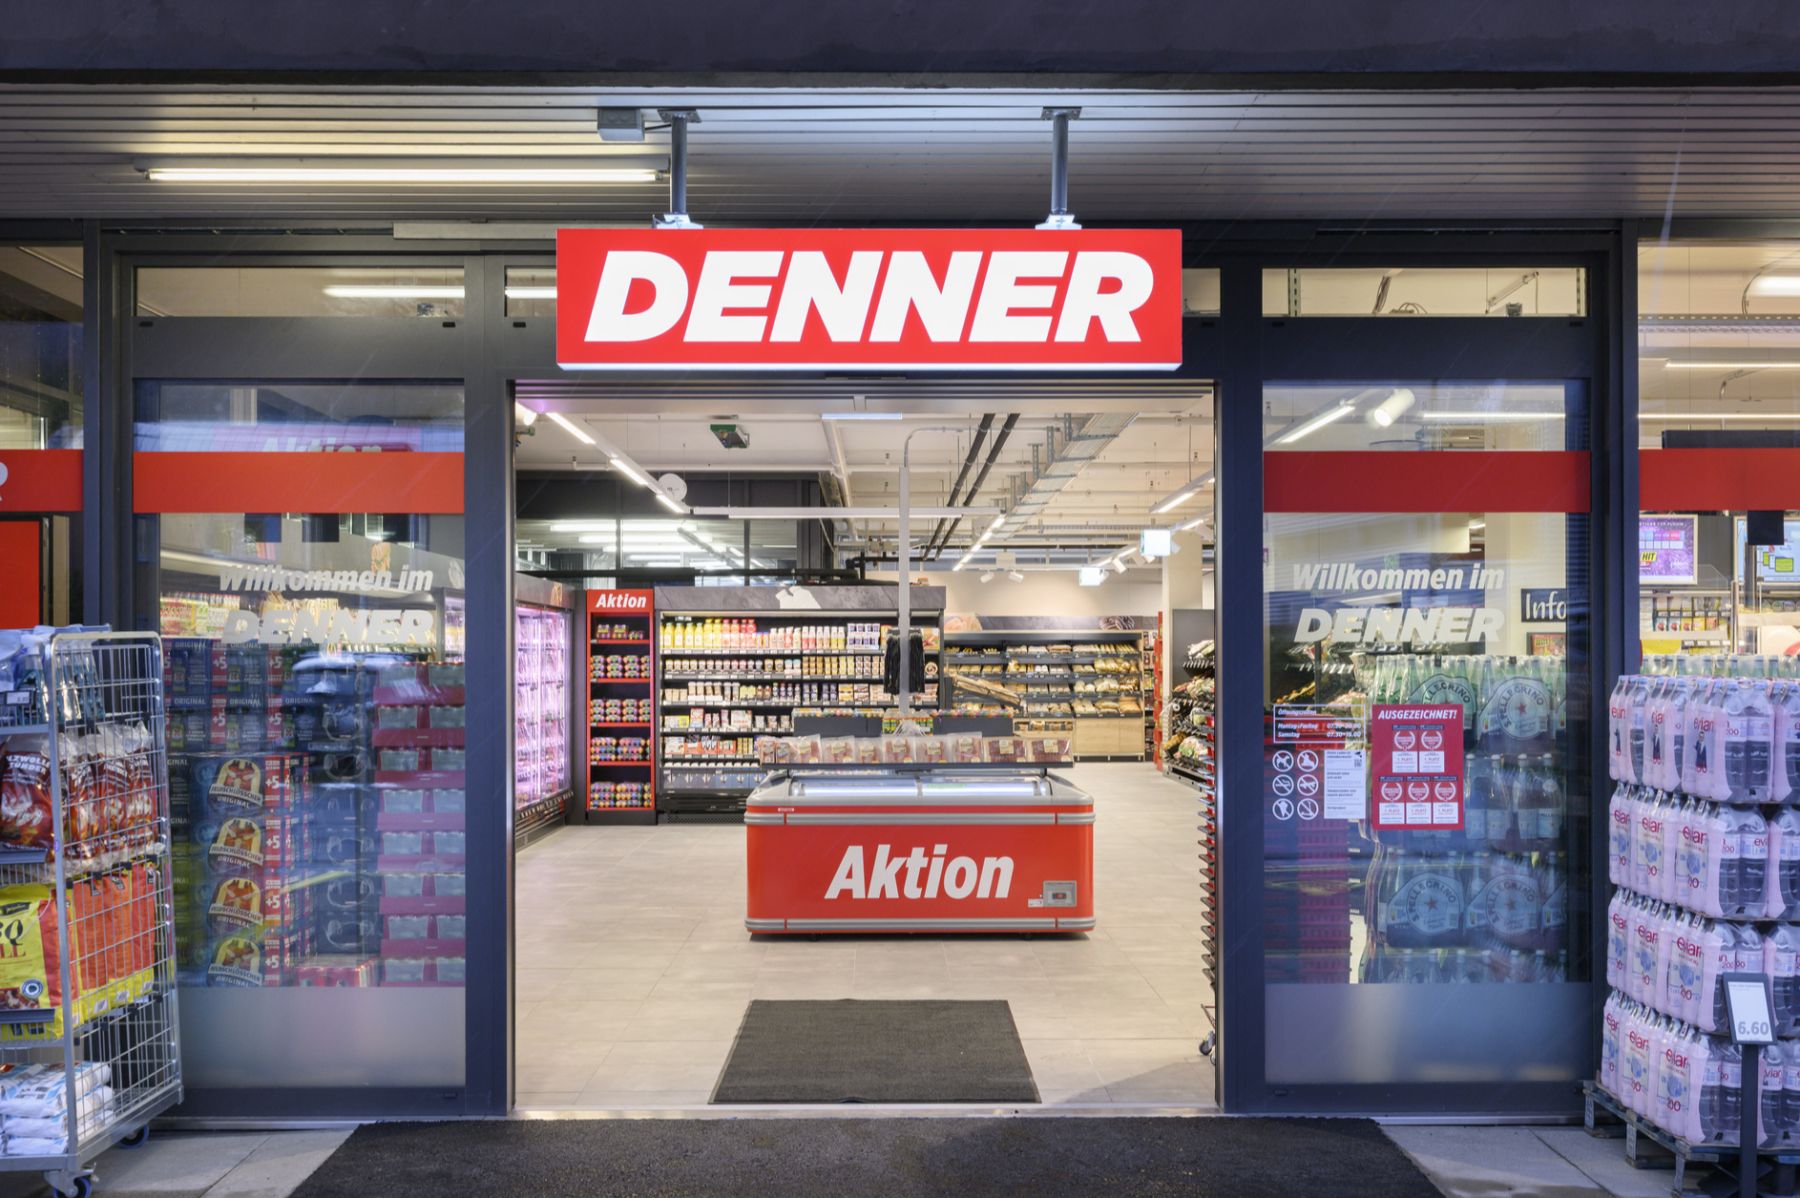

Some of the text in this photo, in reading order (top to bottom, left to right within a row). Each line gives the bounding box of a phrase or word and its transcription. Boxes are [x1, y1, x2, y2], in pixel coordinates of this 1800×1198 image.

[584, 250, 1154, 342] DENNER
[219, 564, 434, 592] Willkommen im
[1293, 563, 1504, 591] Willkommen im
[595, 593, 647, 609] Aktion
[1525, 590, 1567, 620] Info
[221, 608, 434, 645] DENNER
[1294, 607, 1505, 643] DENNER
[1378, 709, 1458, 720] AUSGEZEICHNET!
[824, 843, 1015, 900] Aktion
[1737, 1020, 1770, 1036] 6.60
